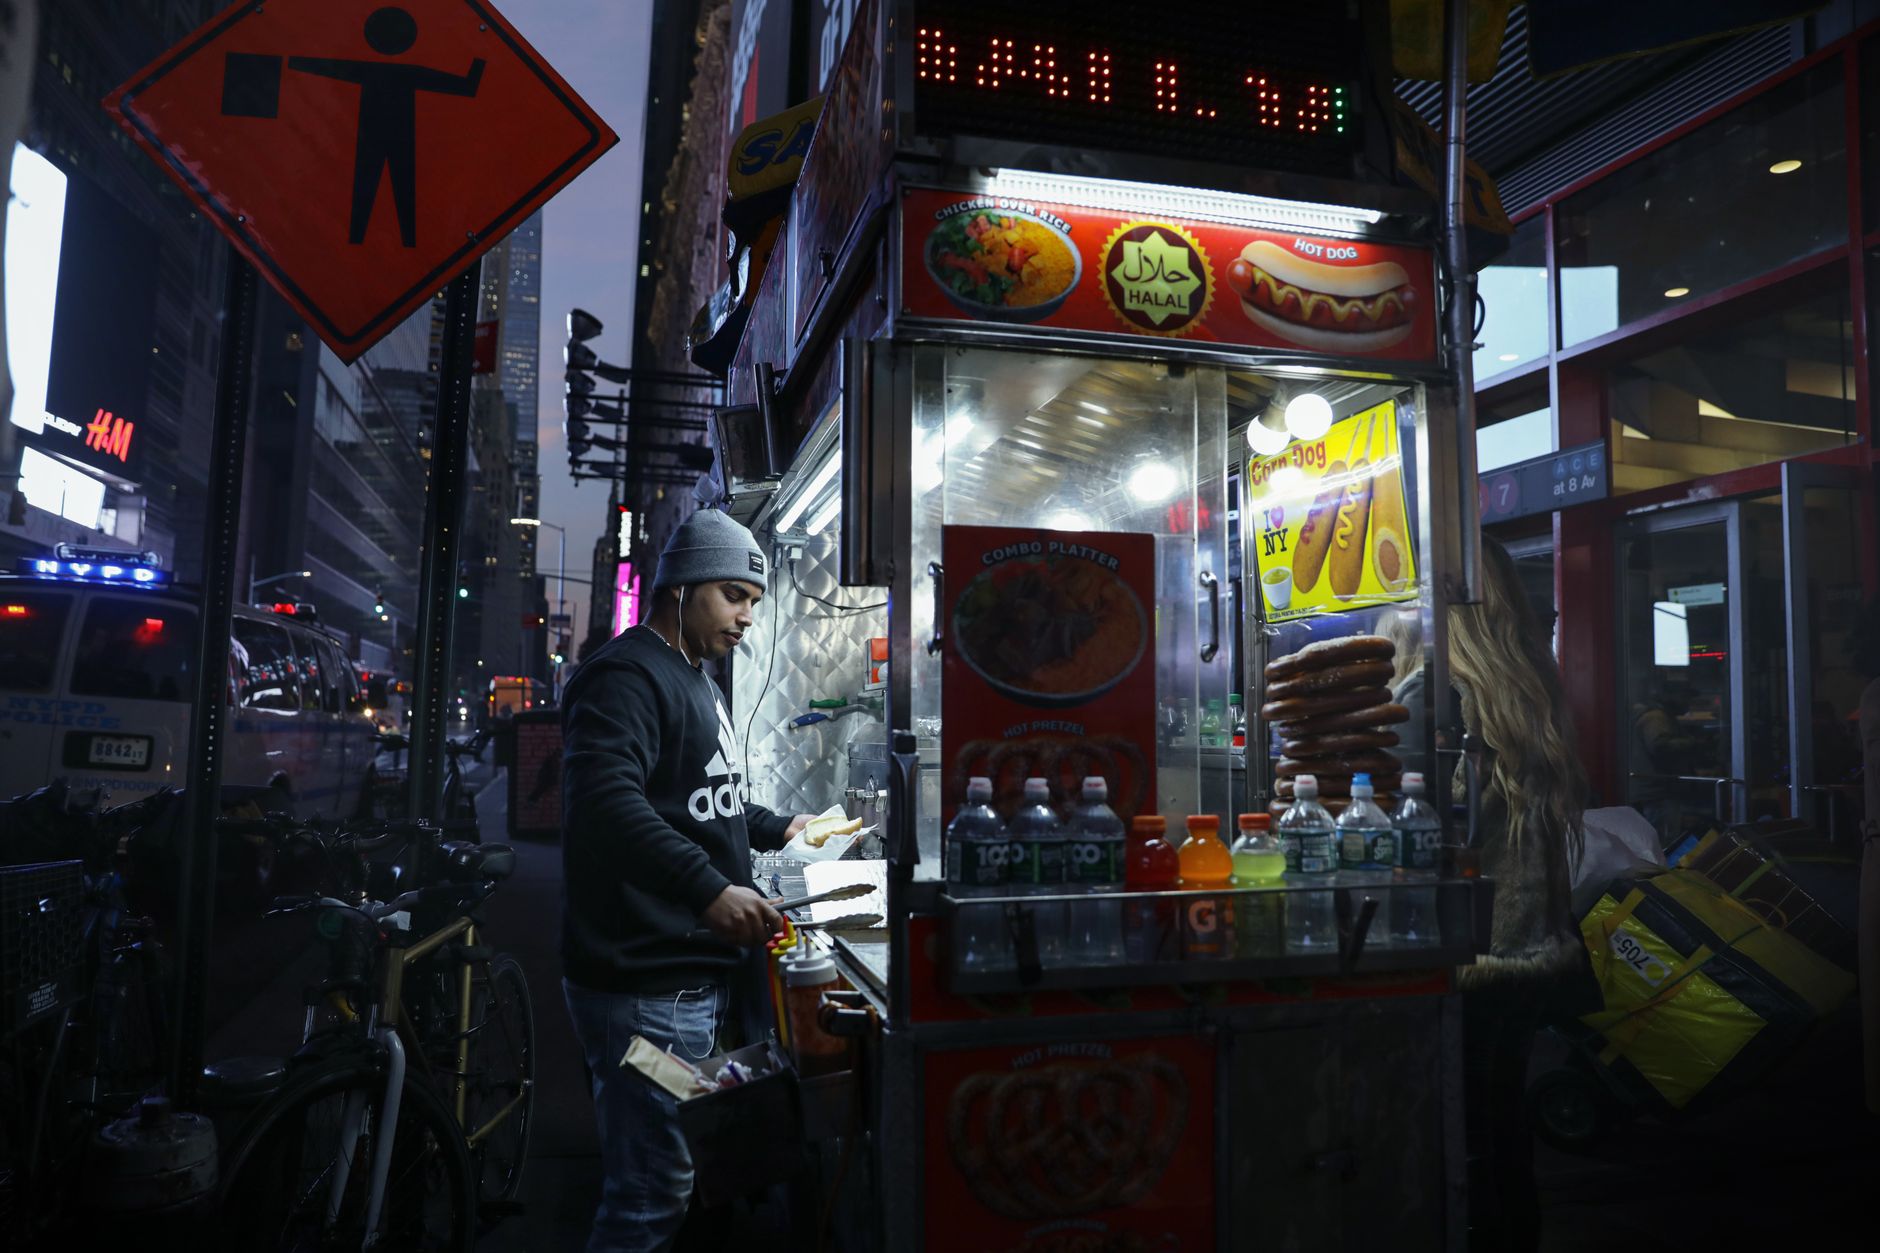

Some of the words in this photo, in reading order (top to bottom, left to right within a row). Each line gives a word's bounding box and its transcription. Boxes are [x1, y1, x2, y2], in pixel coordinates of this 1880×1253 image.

[934, 197, 995, 221] CHICKEN
[999, 198, 1037, 217] OVER
[1038, 208, 1073, 235] RICE
[1294, 238, 1324, 257] HOT
[1326, 246, 1359, 260] DOG
[1123, 246, 1190, 283] حلال
[1128, 289, 1188, 309] HALAL
[1251, 455, 1288, 486] Corn
[1292, 440, 1327, 470] Dog
[1498, 483, 1511, 507] 7
[1553, 481, 1565, 496] at
[1568, 476, 1578, 493] 8
[1580, 474, 1597, 490] Av
[1263, 509, 1272, 533] I
[1263, 527, 1289, 557] NY
[981, 541, 1043, 566] COMBO
[1048, 541, 1120, 571] PLATTER
[35, 560, 156, 582] NYPD
[8, 696, 107, 714] NYPD
[0, 710, 121, 729] POLICE
[1002, 722, 1029, 737] HOT
[1030, 719, 1086, 737] PRETZEL
[1188, 899, 1217, 933] G
[1617, 938, 1649, 970] 705
